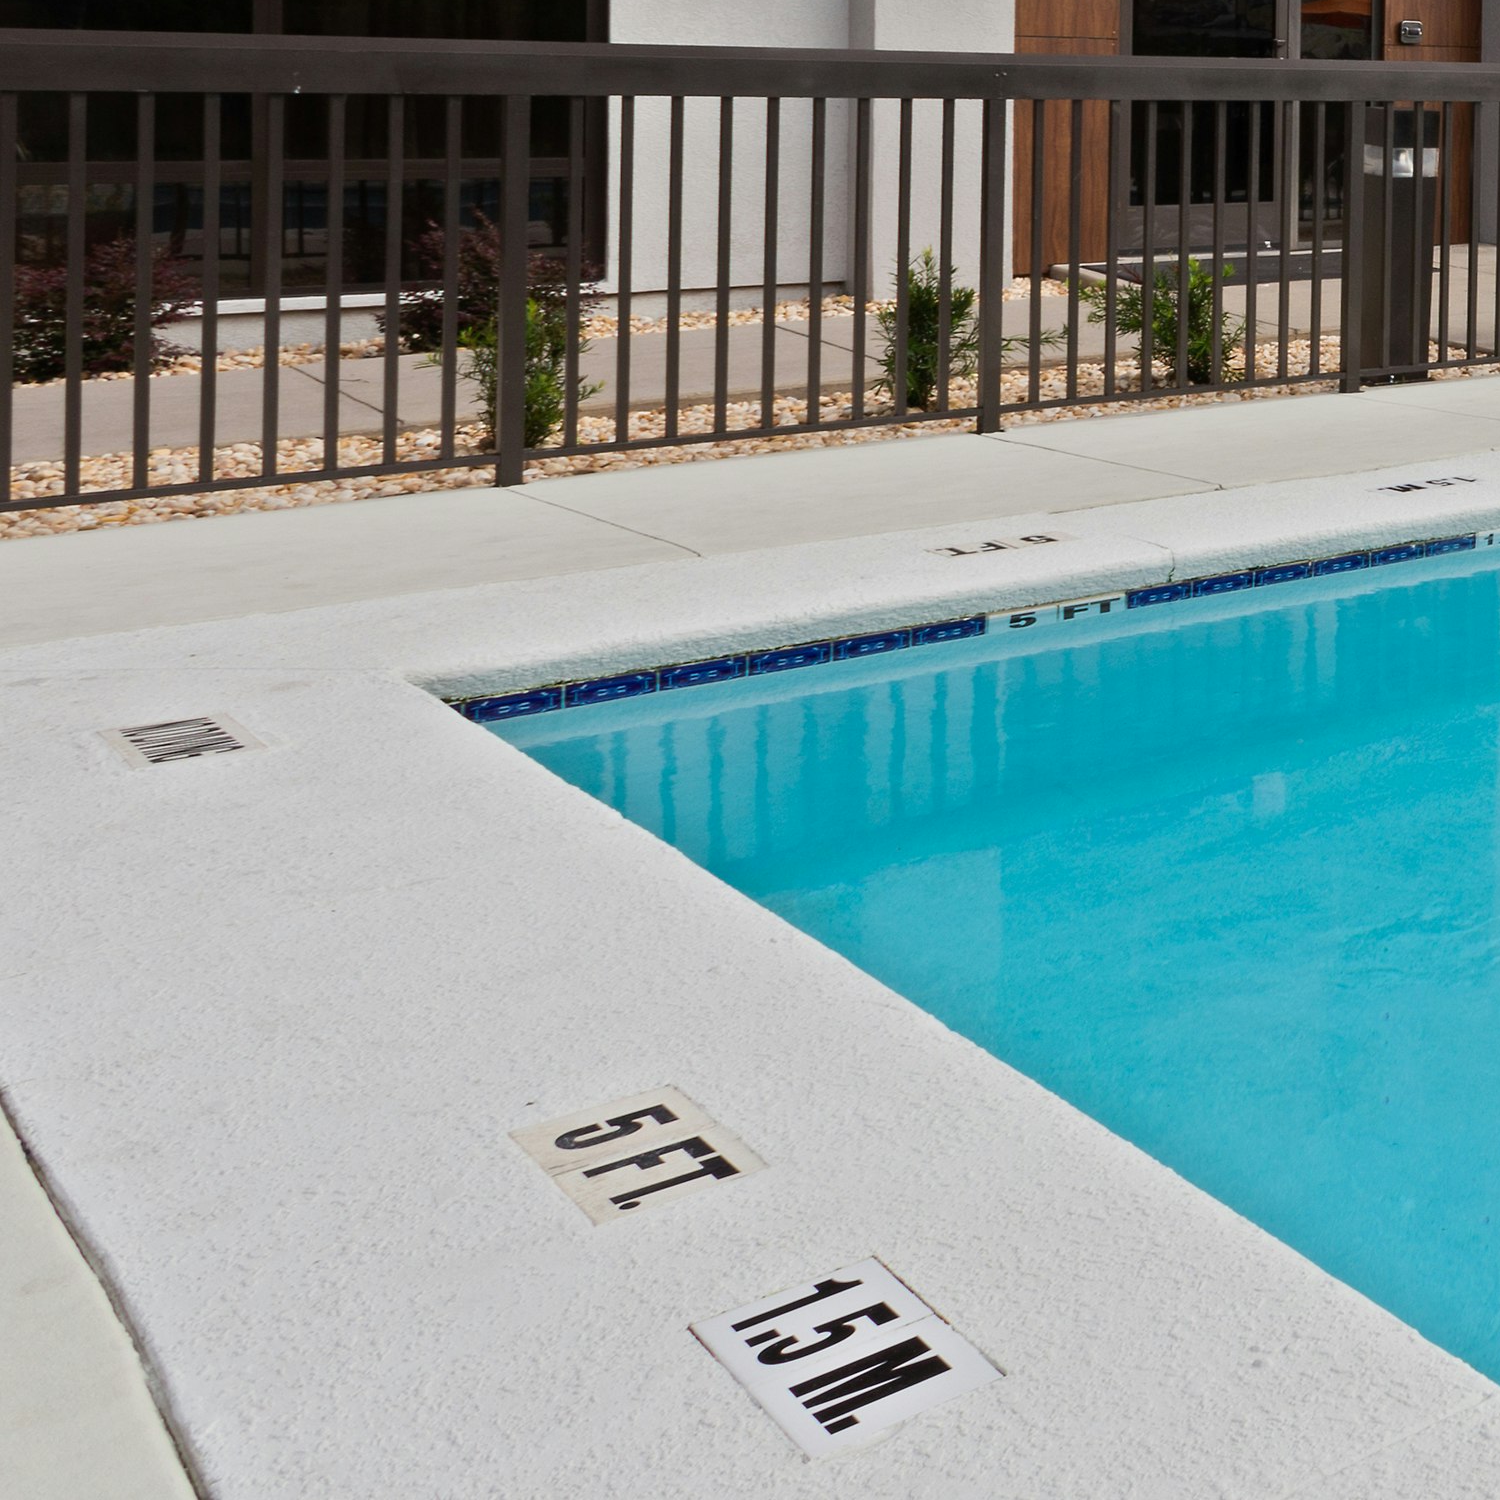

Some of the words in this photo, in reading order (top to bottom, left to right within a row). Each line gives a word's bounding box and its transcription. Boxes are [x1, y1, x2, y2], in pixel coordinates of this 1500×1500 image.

[1009, 611, 1036, 628] 5
[1063, 597, 1121, 620] FT
[554, 1103, 680, 1151] 5
[581, 1135, 741, 1211] FT.
[731, 1278, 902, 1366] 1.5
[788, 1335, 953, 1436] M.
